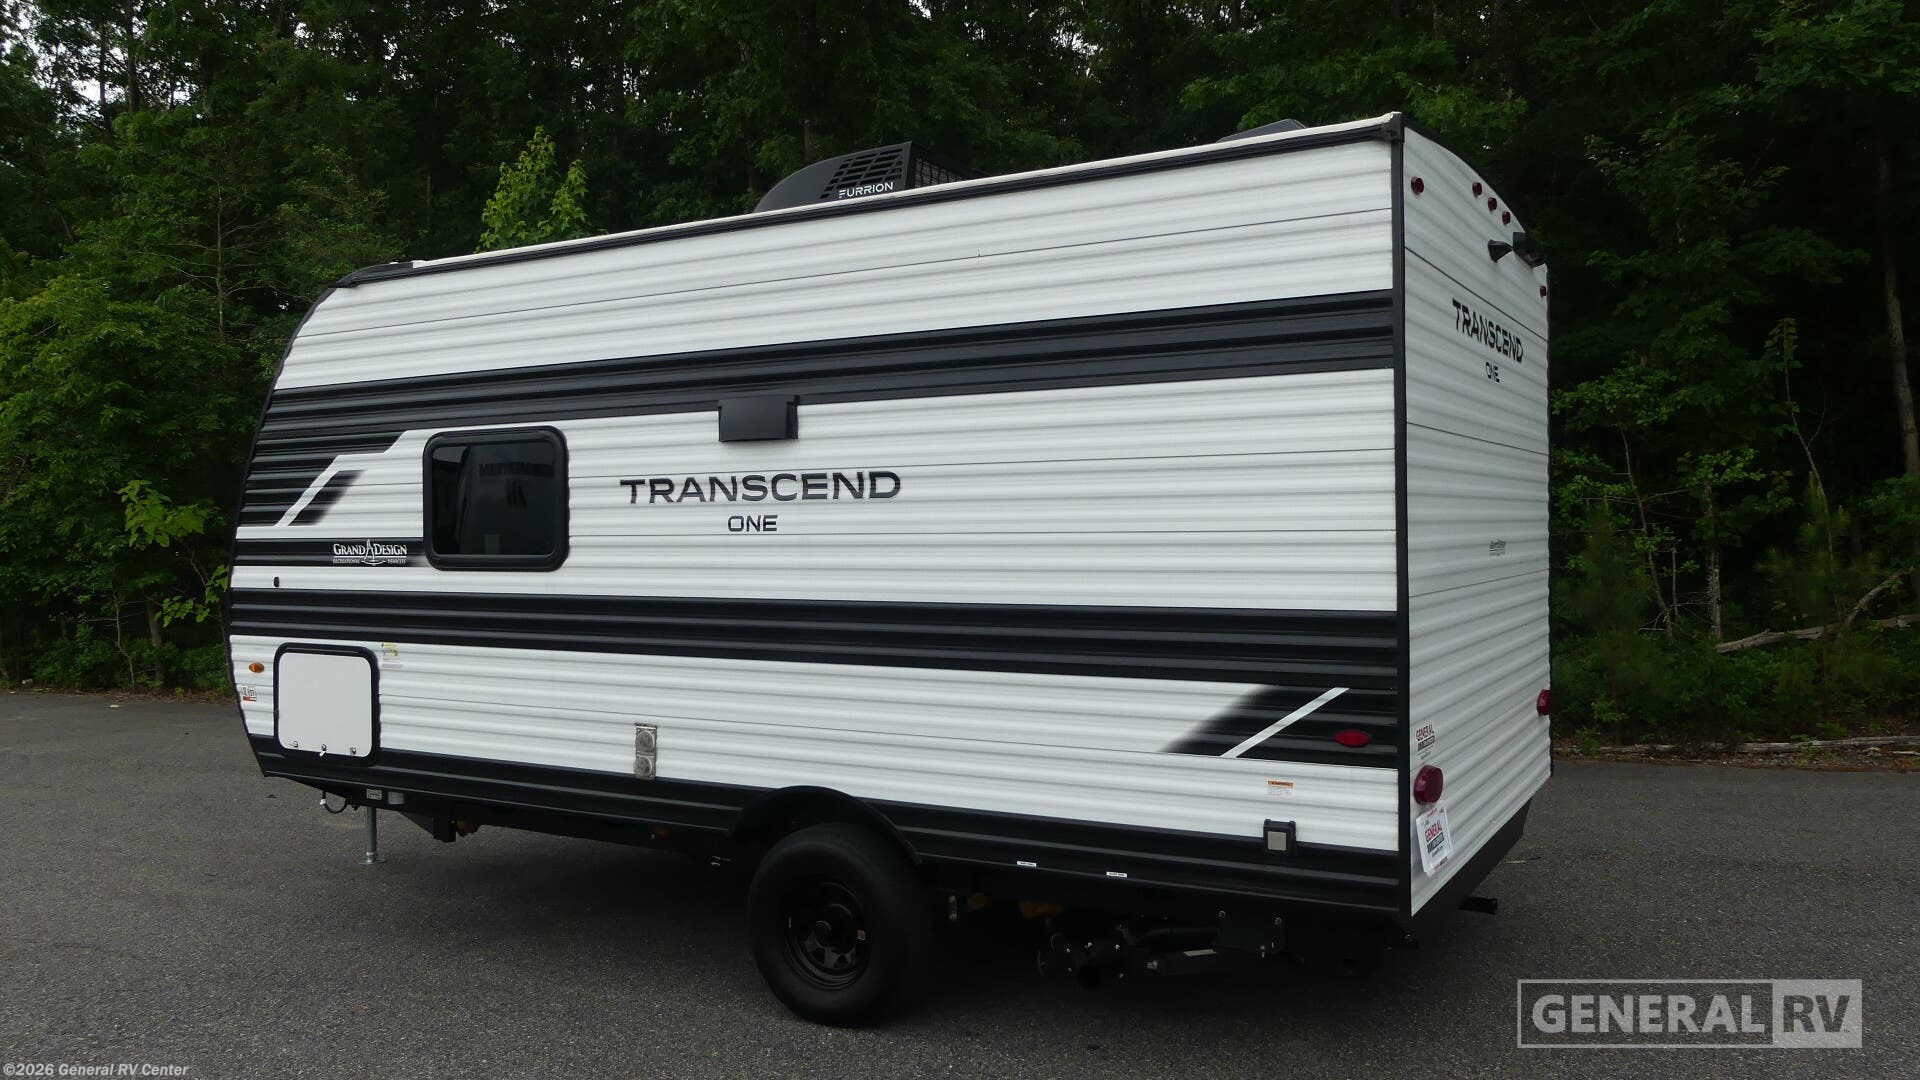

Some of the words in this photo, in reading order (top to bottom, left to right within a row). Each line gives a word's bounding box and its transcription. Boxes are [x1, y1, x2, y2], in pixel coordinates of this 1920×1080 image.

[838, 181, 894, 199] FURRION
[1452, 298, 1524, 363] TRANSCEND
[1485, 361, 1500, 383] ONE
[620, 471, 901, 504] TRANSCEND
[727, 515, 778, 532] ONE
